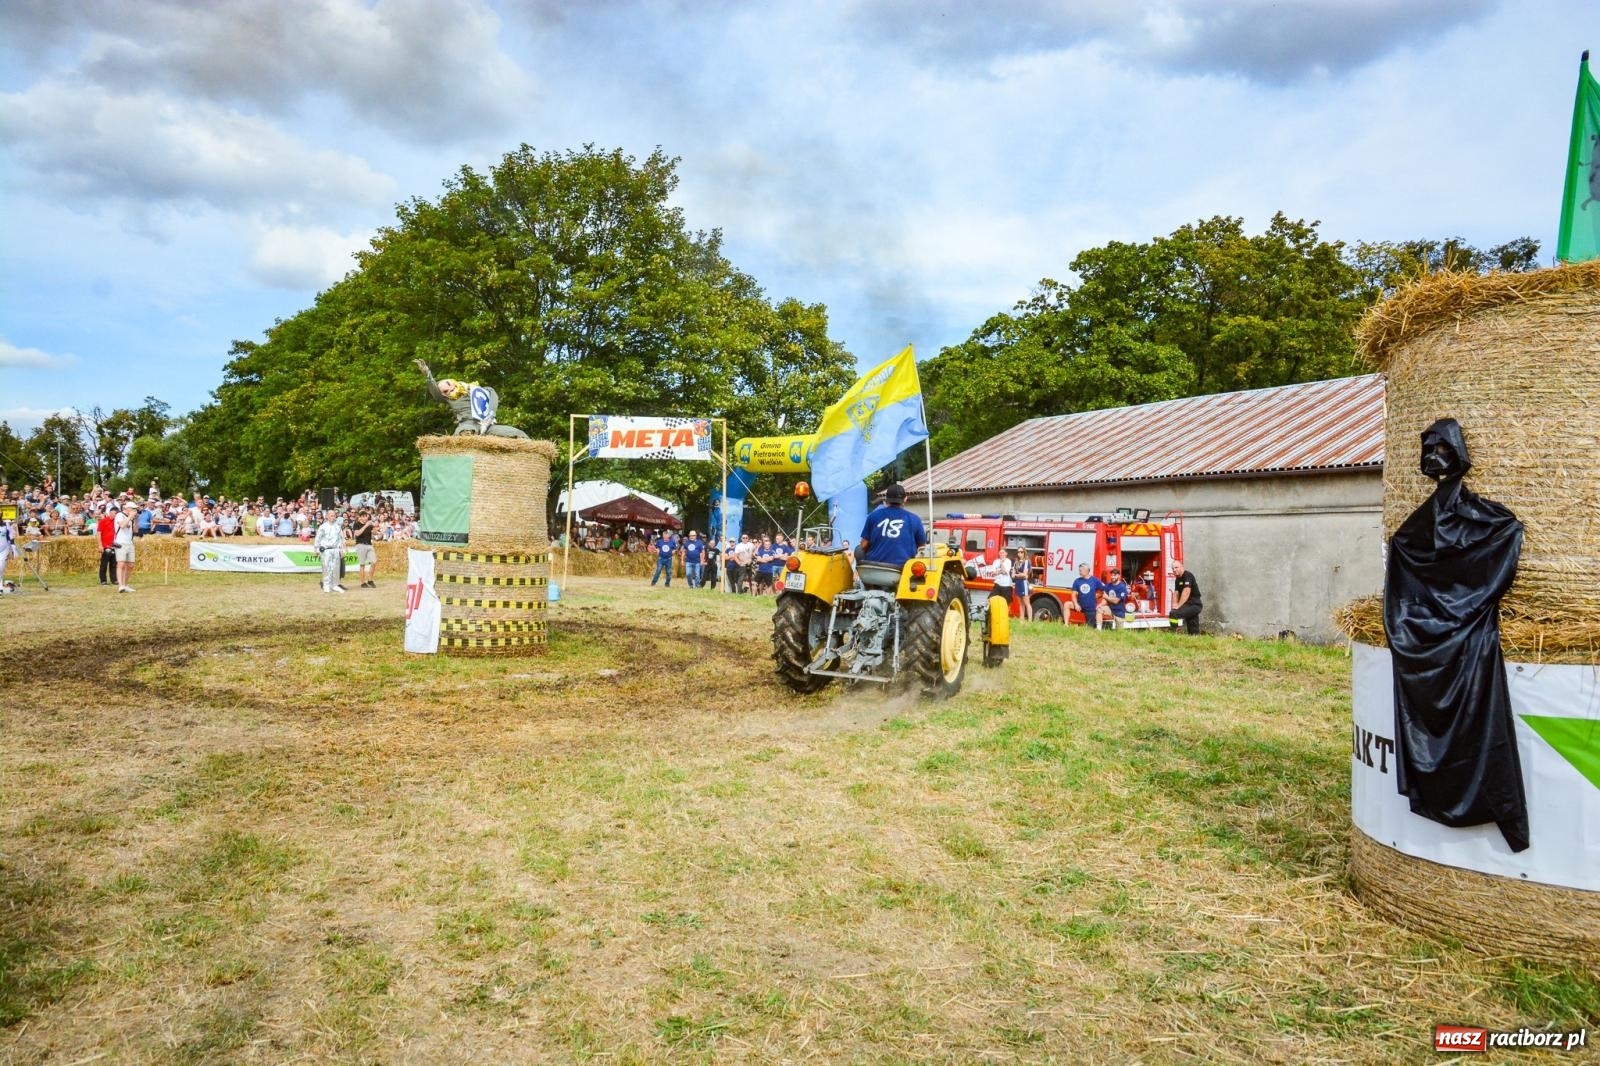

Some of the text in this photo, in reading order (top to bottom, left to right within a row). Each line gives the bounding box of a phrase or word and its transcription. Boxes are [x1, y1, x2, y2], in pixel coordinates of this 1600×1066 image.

[610, 429, 694, 448] META
[877, 518, 904, 539] 18
[1055, 548, 1074, 571] 24
